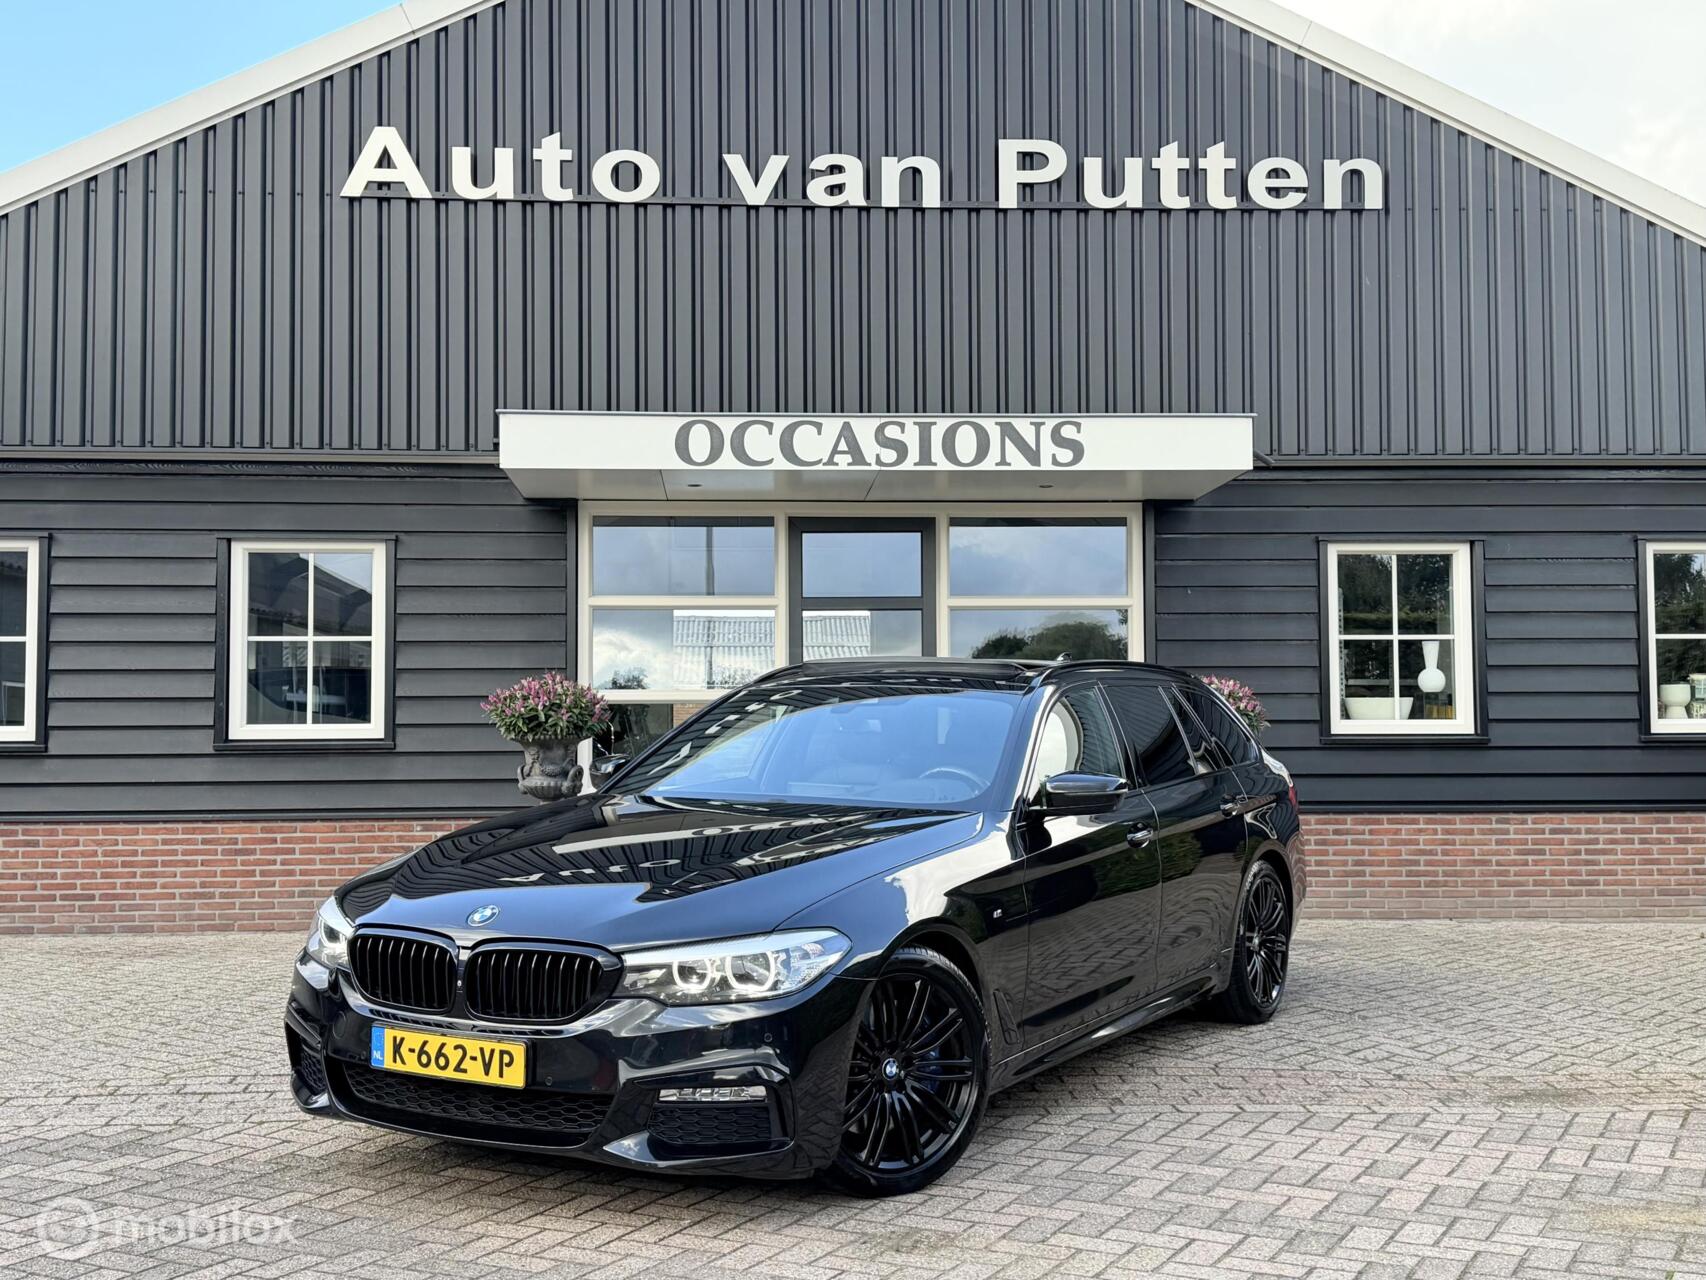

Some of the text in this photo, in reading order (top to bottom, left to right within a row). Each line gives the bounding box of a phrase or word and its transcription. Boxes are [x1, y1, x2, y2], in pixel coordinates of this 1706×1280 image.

[340, 126, 1384, 211] Auto van Putten
[675, 419, 1085, 468] OCCASIONS
[372, 1050, 383, 1061] NL
[392, 1035, 515, 1079] K-662-VP
